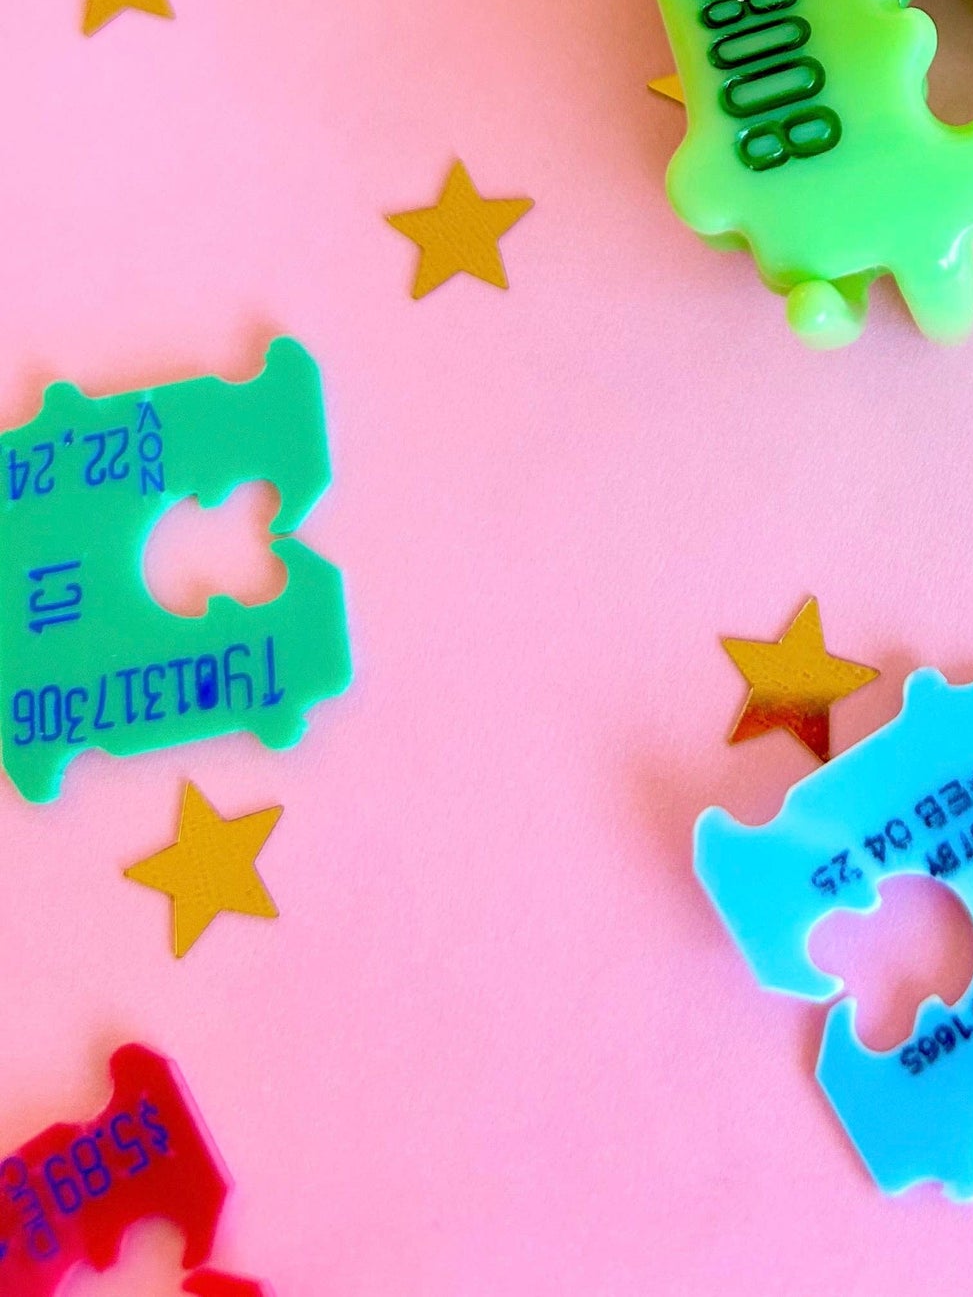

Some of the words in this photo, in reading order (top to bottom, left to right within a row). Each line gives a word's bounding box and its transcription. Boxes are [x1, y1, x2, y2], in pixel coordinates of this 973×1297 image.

[863, 818, 913, 865] 04
[925, 839, 962, 878] BY
[810, 848, 864, 896] 25
[42, 1098, 169, 1216] $5.89
